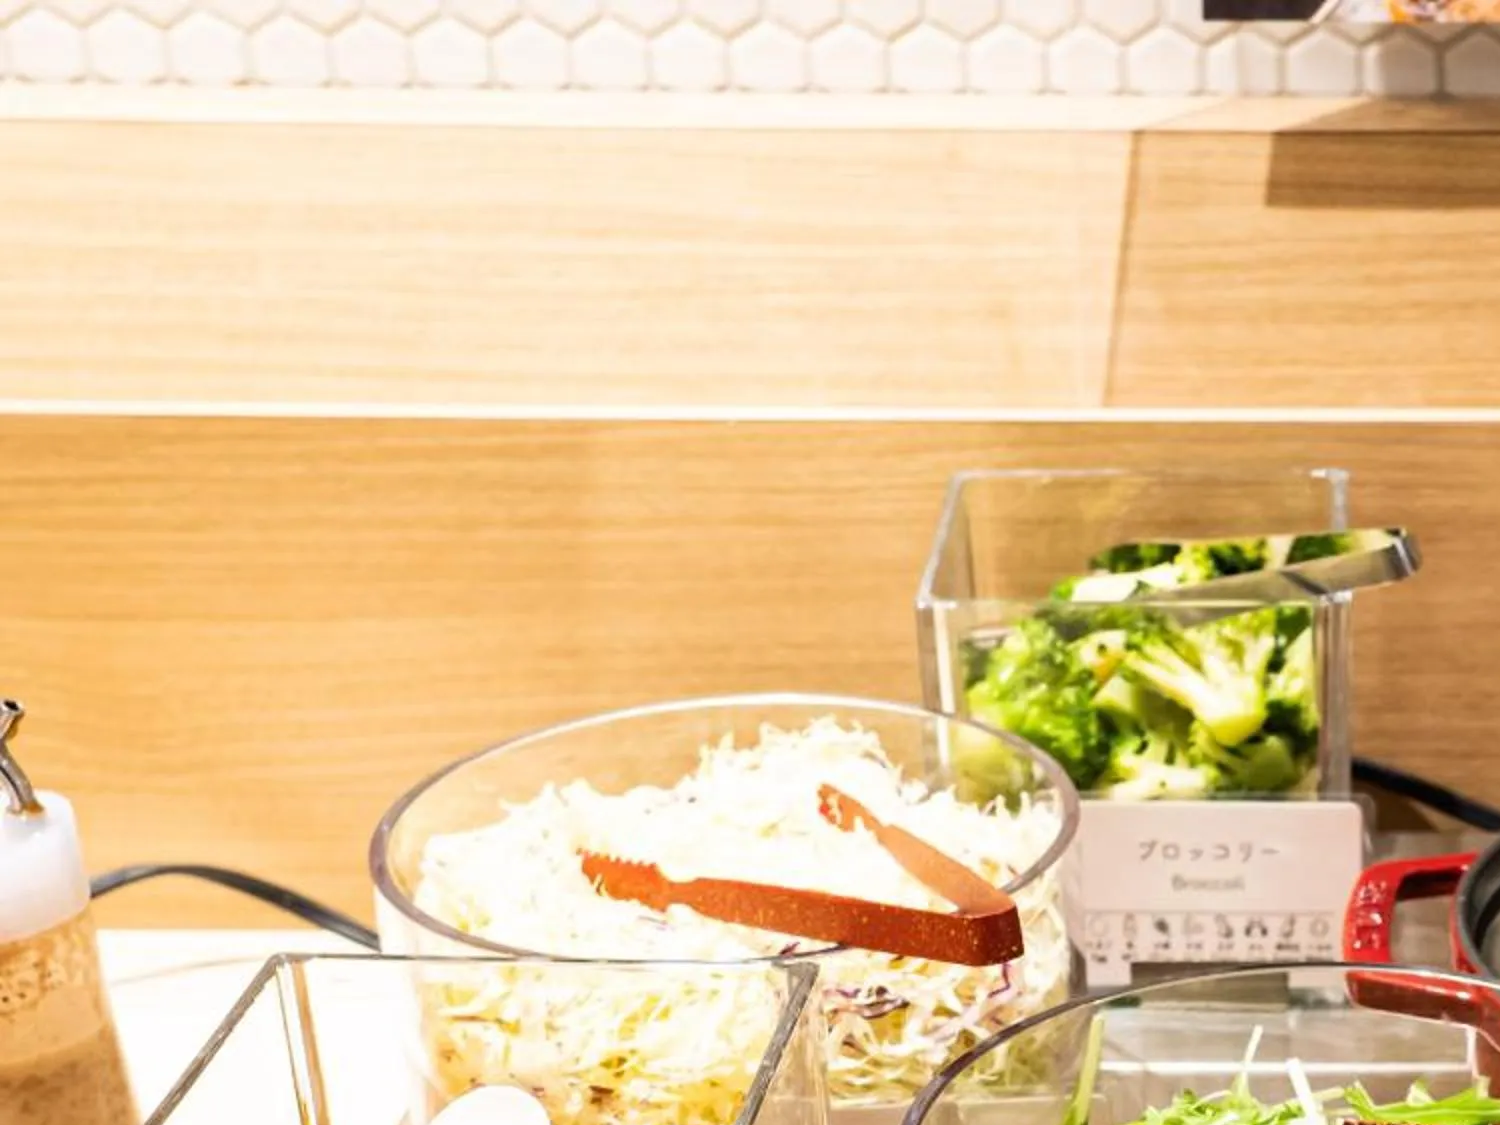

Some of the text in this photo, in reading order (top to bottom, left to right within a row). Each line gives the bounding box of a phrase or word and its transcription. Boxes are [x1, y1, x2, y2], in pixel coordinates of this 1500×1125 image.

[1138, 840, 1281, 863] ブロッコリー
